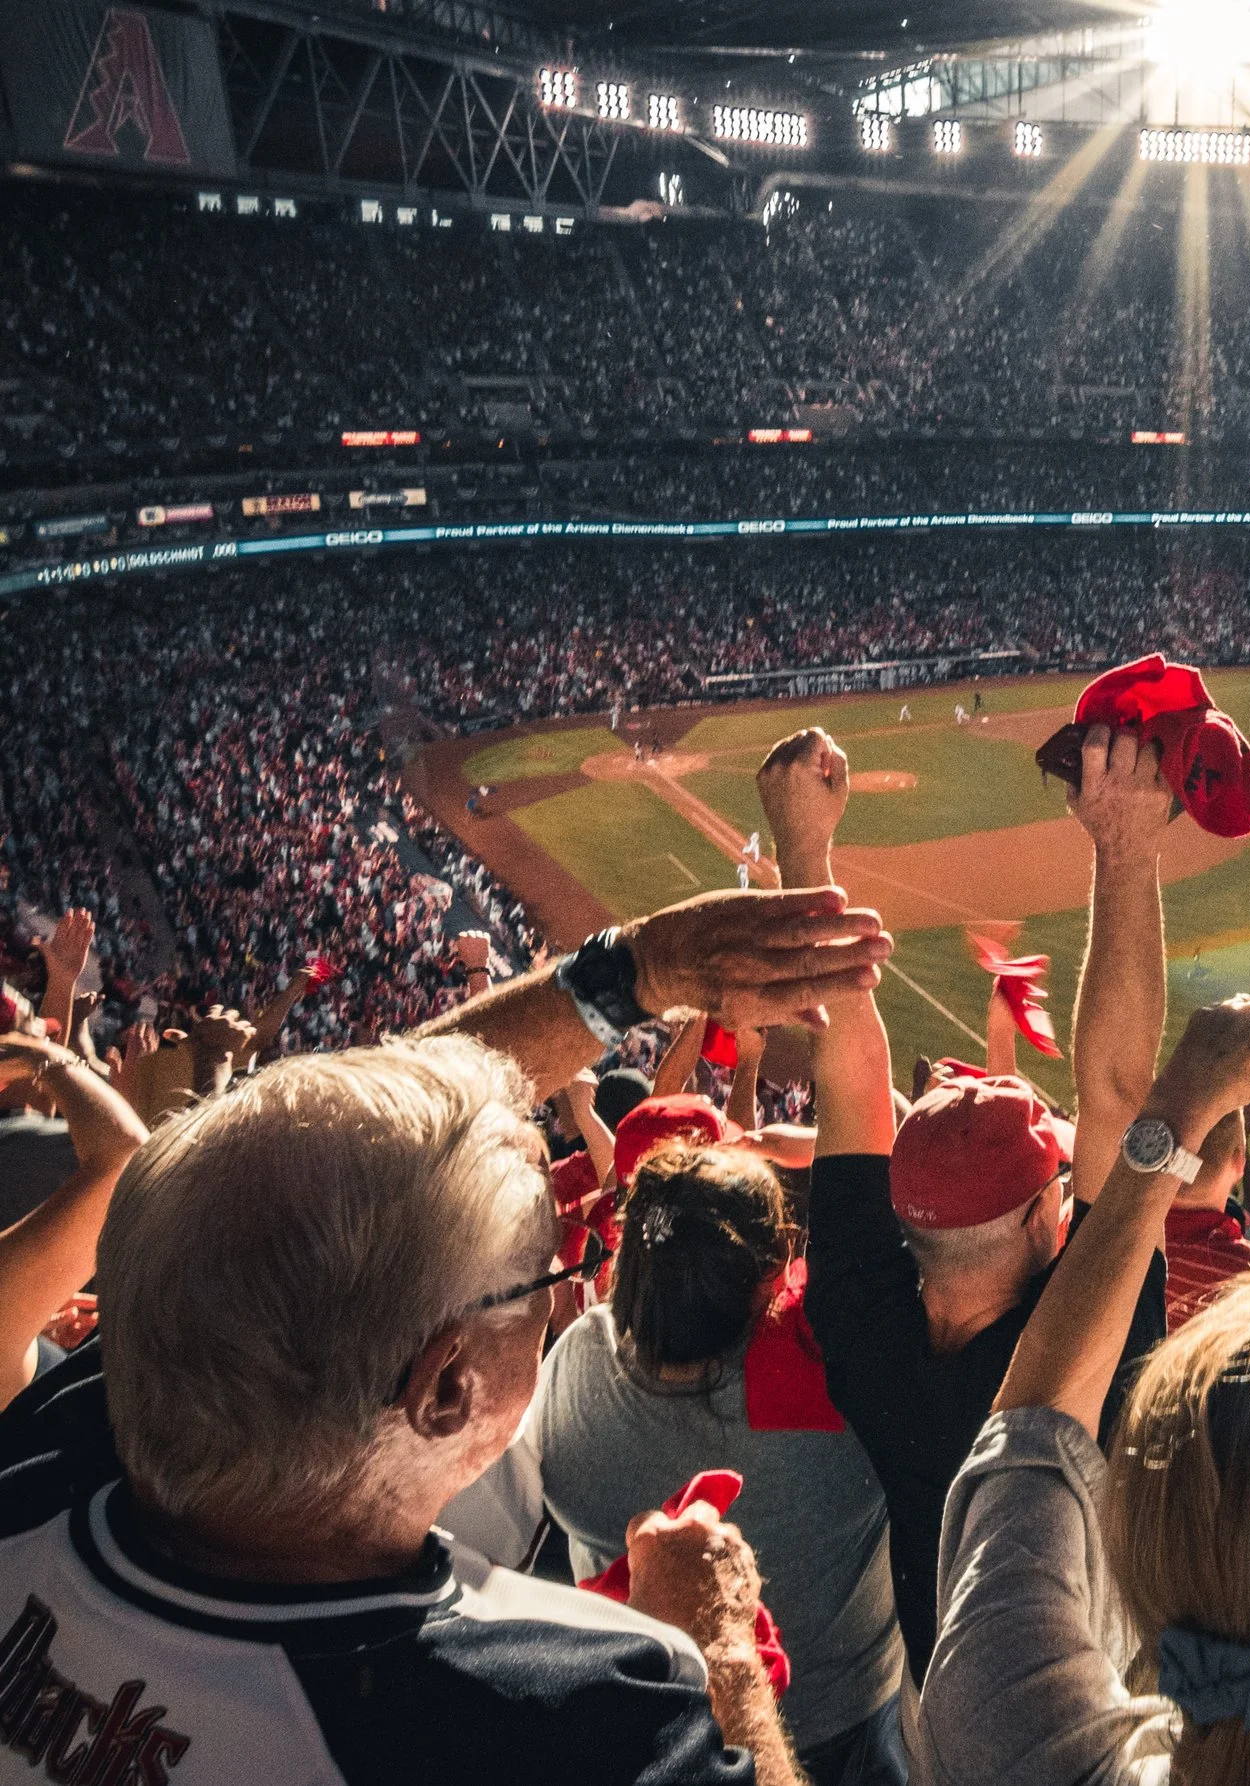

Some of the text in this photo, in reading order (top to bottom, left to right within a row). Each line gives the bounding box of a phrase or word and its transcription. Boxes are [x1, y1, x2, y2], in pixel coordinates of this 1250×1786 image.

[828, 513, 1035, 529] Proud Partner of the Arizona Diamondbacks
[1071, 512, 1113, 524] GEICO
[1151, 513, 1179, 523] Proud
[1180, 513, 1215, 523] Partner
[1226, 512, 1242, 523] the
[435, 522, 694, 539] Proud Partner of the Arizona Diamondbacks
[738, 519, 786, 534] GEICO
[325, 529, 384, 547] GEICO
[129, 545, 204, 569] GOLDSCHMIDT
[0, 1593, 190, 1786] backs
